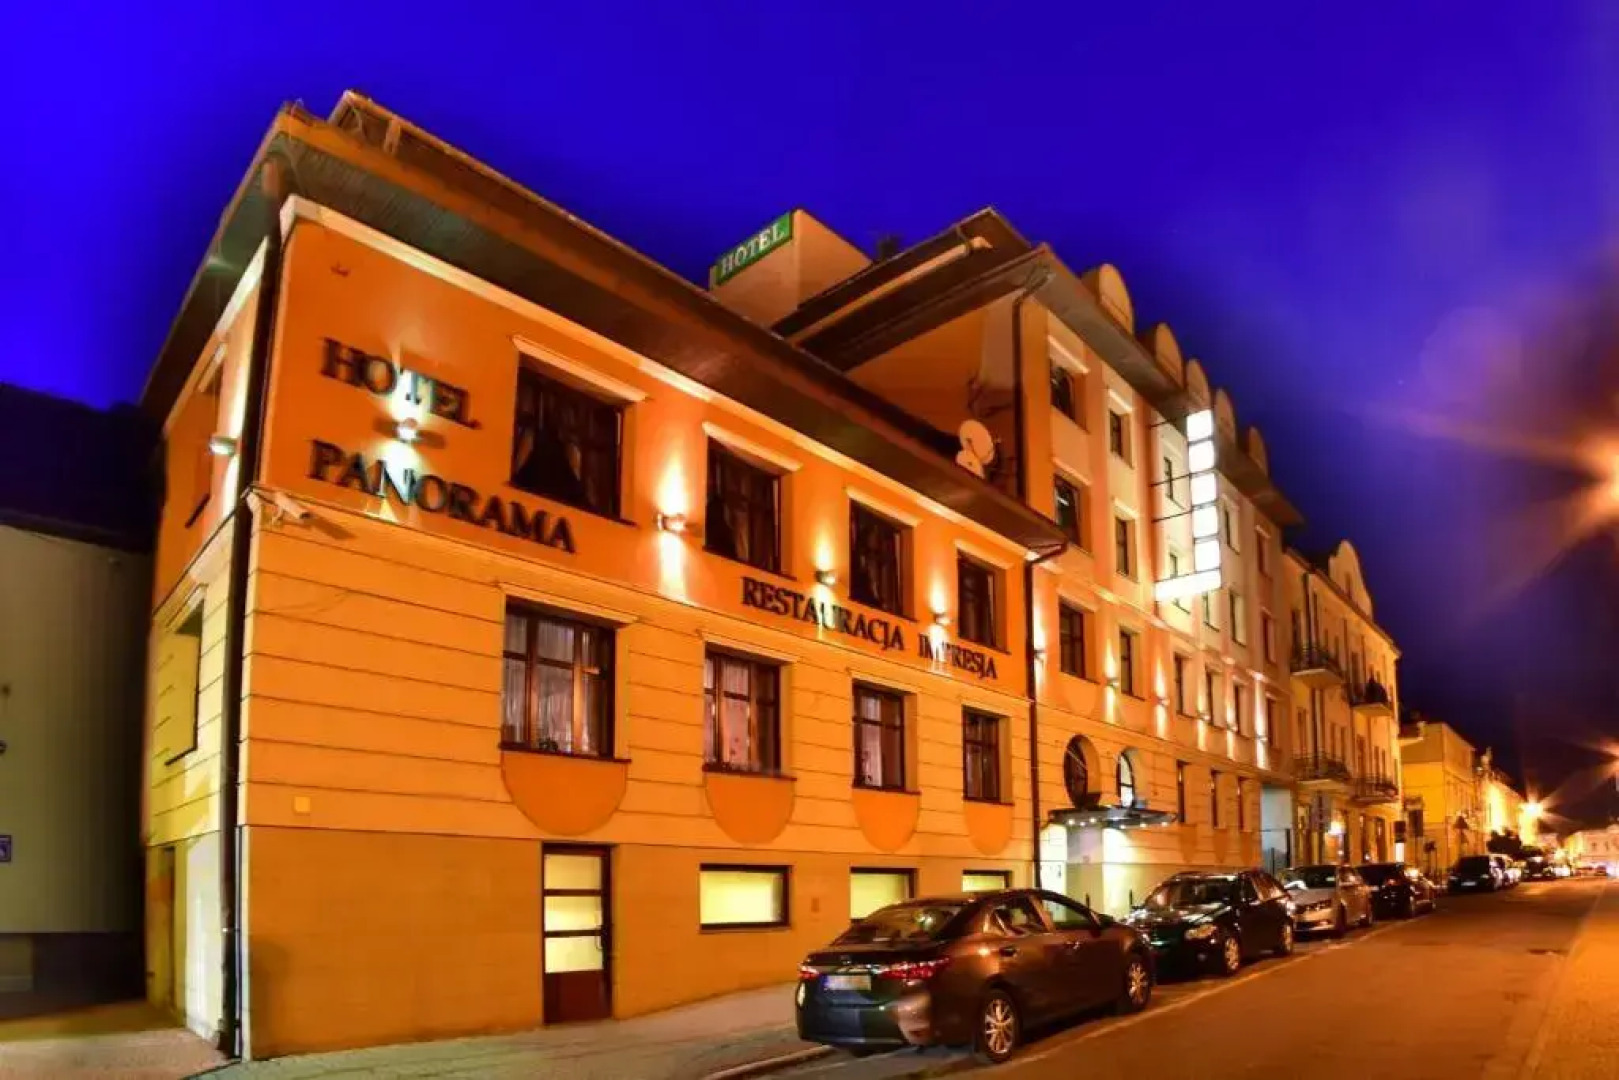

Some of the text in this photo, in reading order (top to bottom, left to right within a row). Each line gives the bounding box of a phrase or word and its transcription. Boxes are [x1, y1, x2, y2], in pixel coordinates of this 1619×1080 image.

[721, 222, 785, 277] HOTEL
[319, 336, 482, 430] HOTEL
[305, 437, 576, 554] PANORAMA
[741, 576, 905, 651] RESTAURACJA
